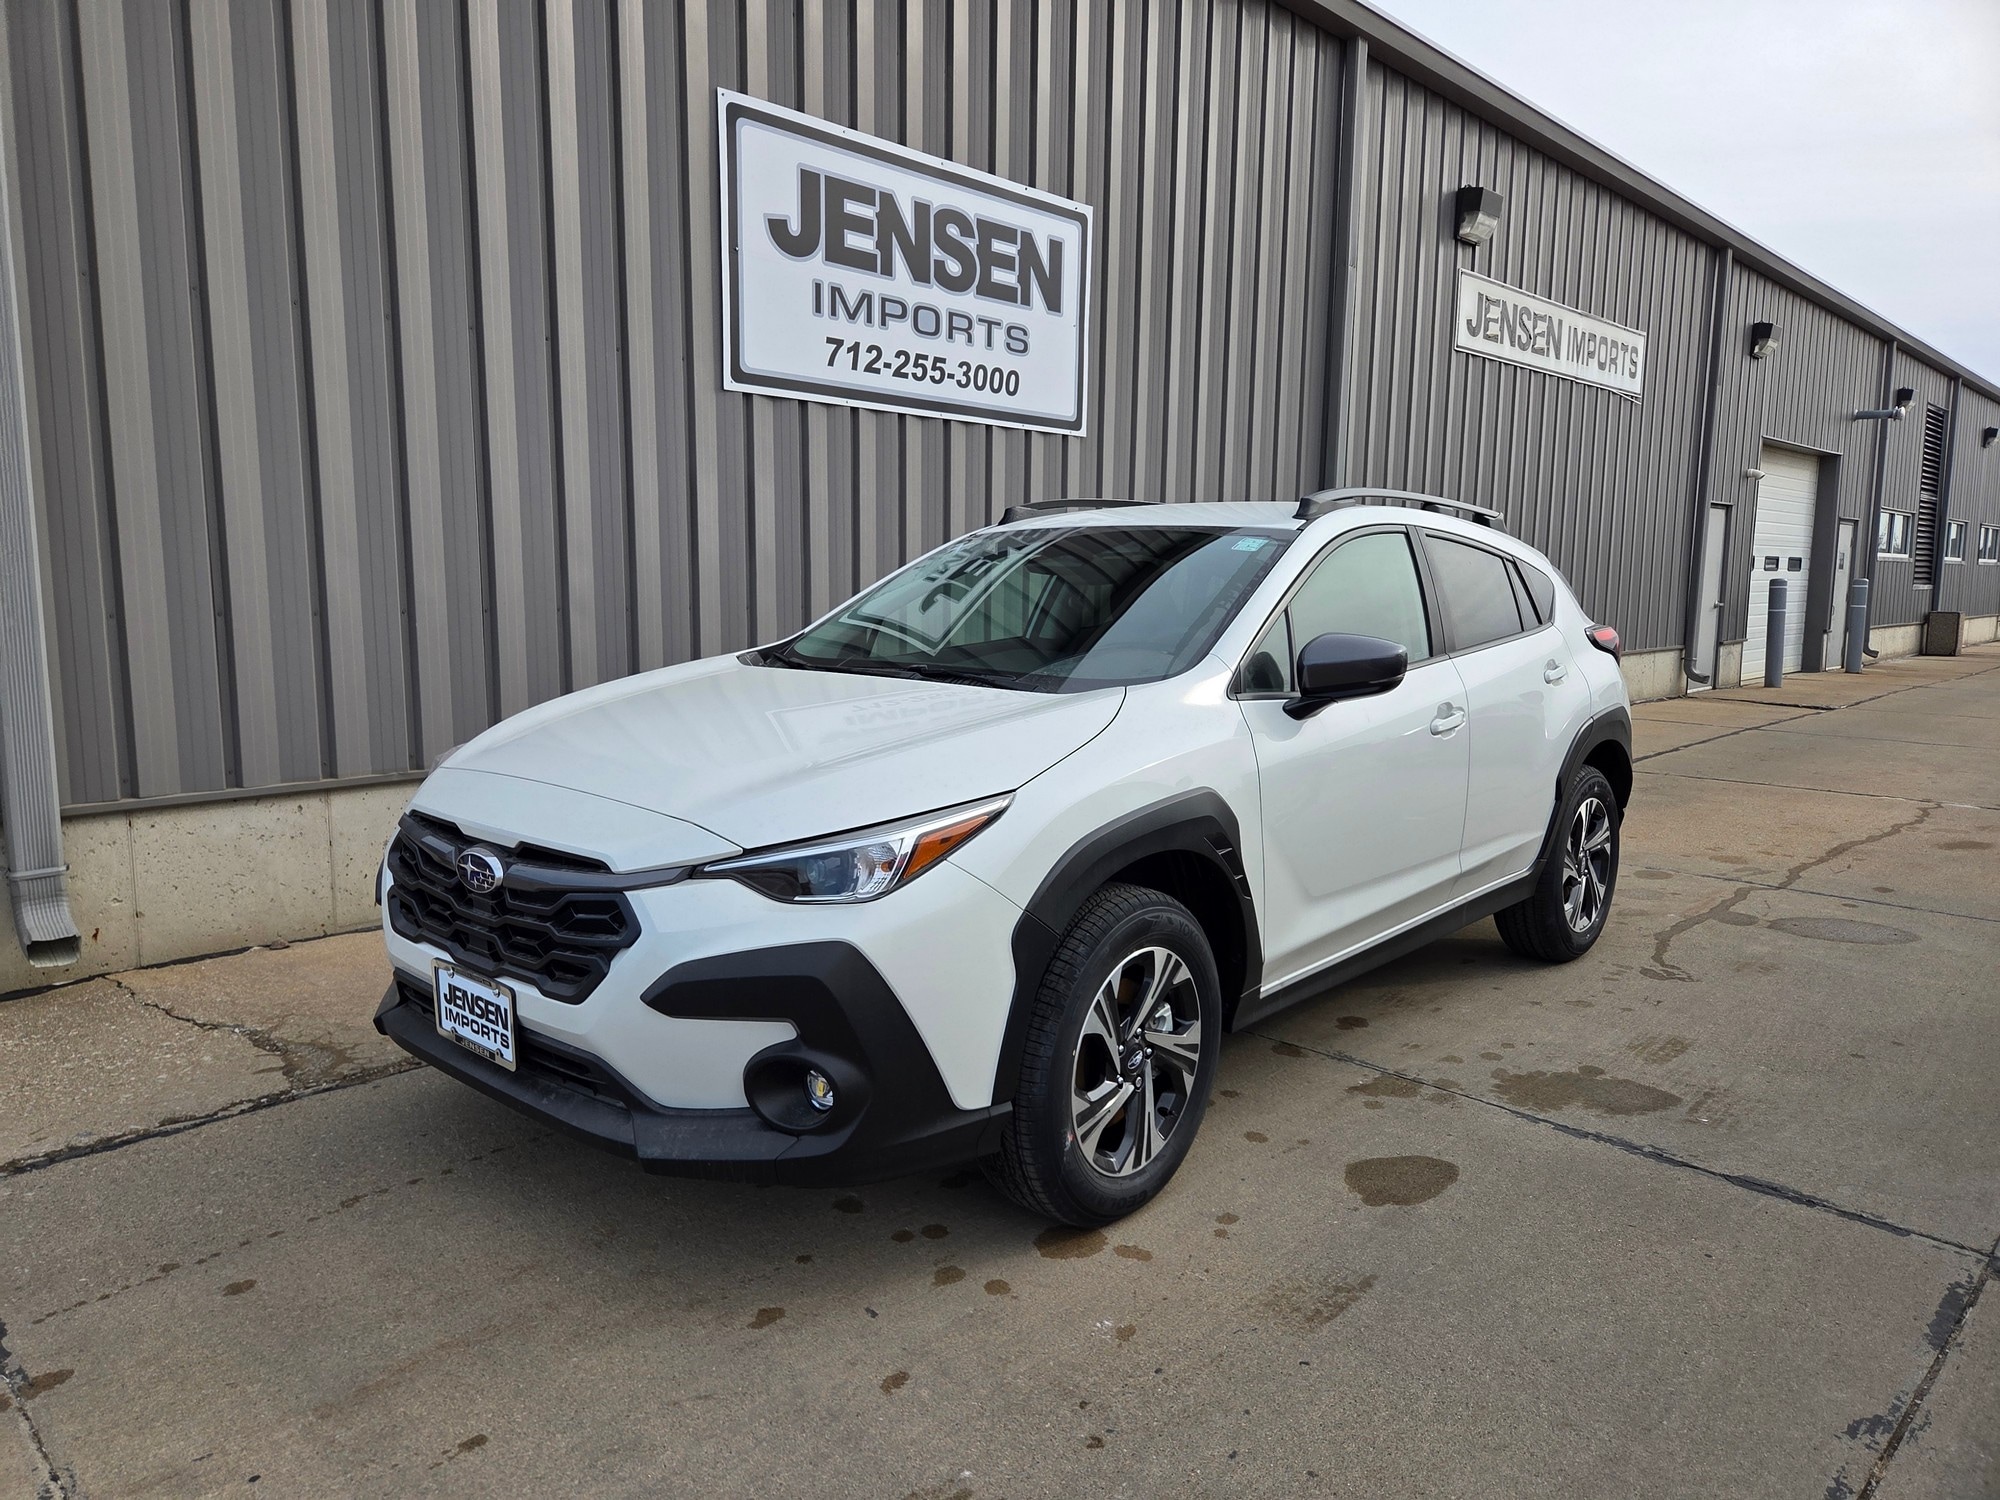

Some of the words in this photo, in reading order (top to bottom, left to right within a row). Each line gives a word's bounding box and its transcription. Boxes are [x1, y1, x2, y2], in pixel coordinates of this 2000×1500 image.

[765, 165, 1064, 315] JENSEN
[812, 279, 1029, 354] IMPORTS
[1466, 291, 1563, 360] JENSEN
[1566, 325, 1639, 379] IMPORTS
[824, 336, 1020, 397] 712-255-3000
[443, 982, 509, 1032] JENSEN
[444, 1006, 510, 1050] IMPORTS
[460, 1039, 490, 1058] JENSEN
